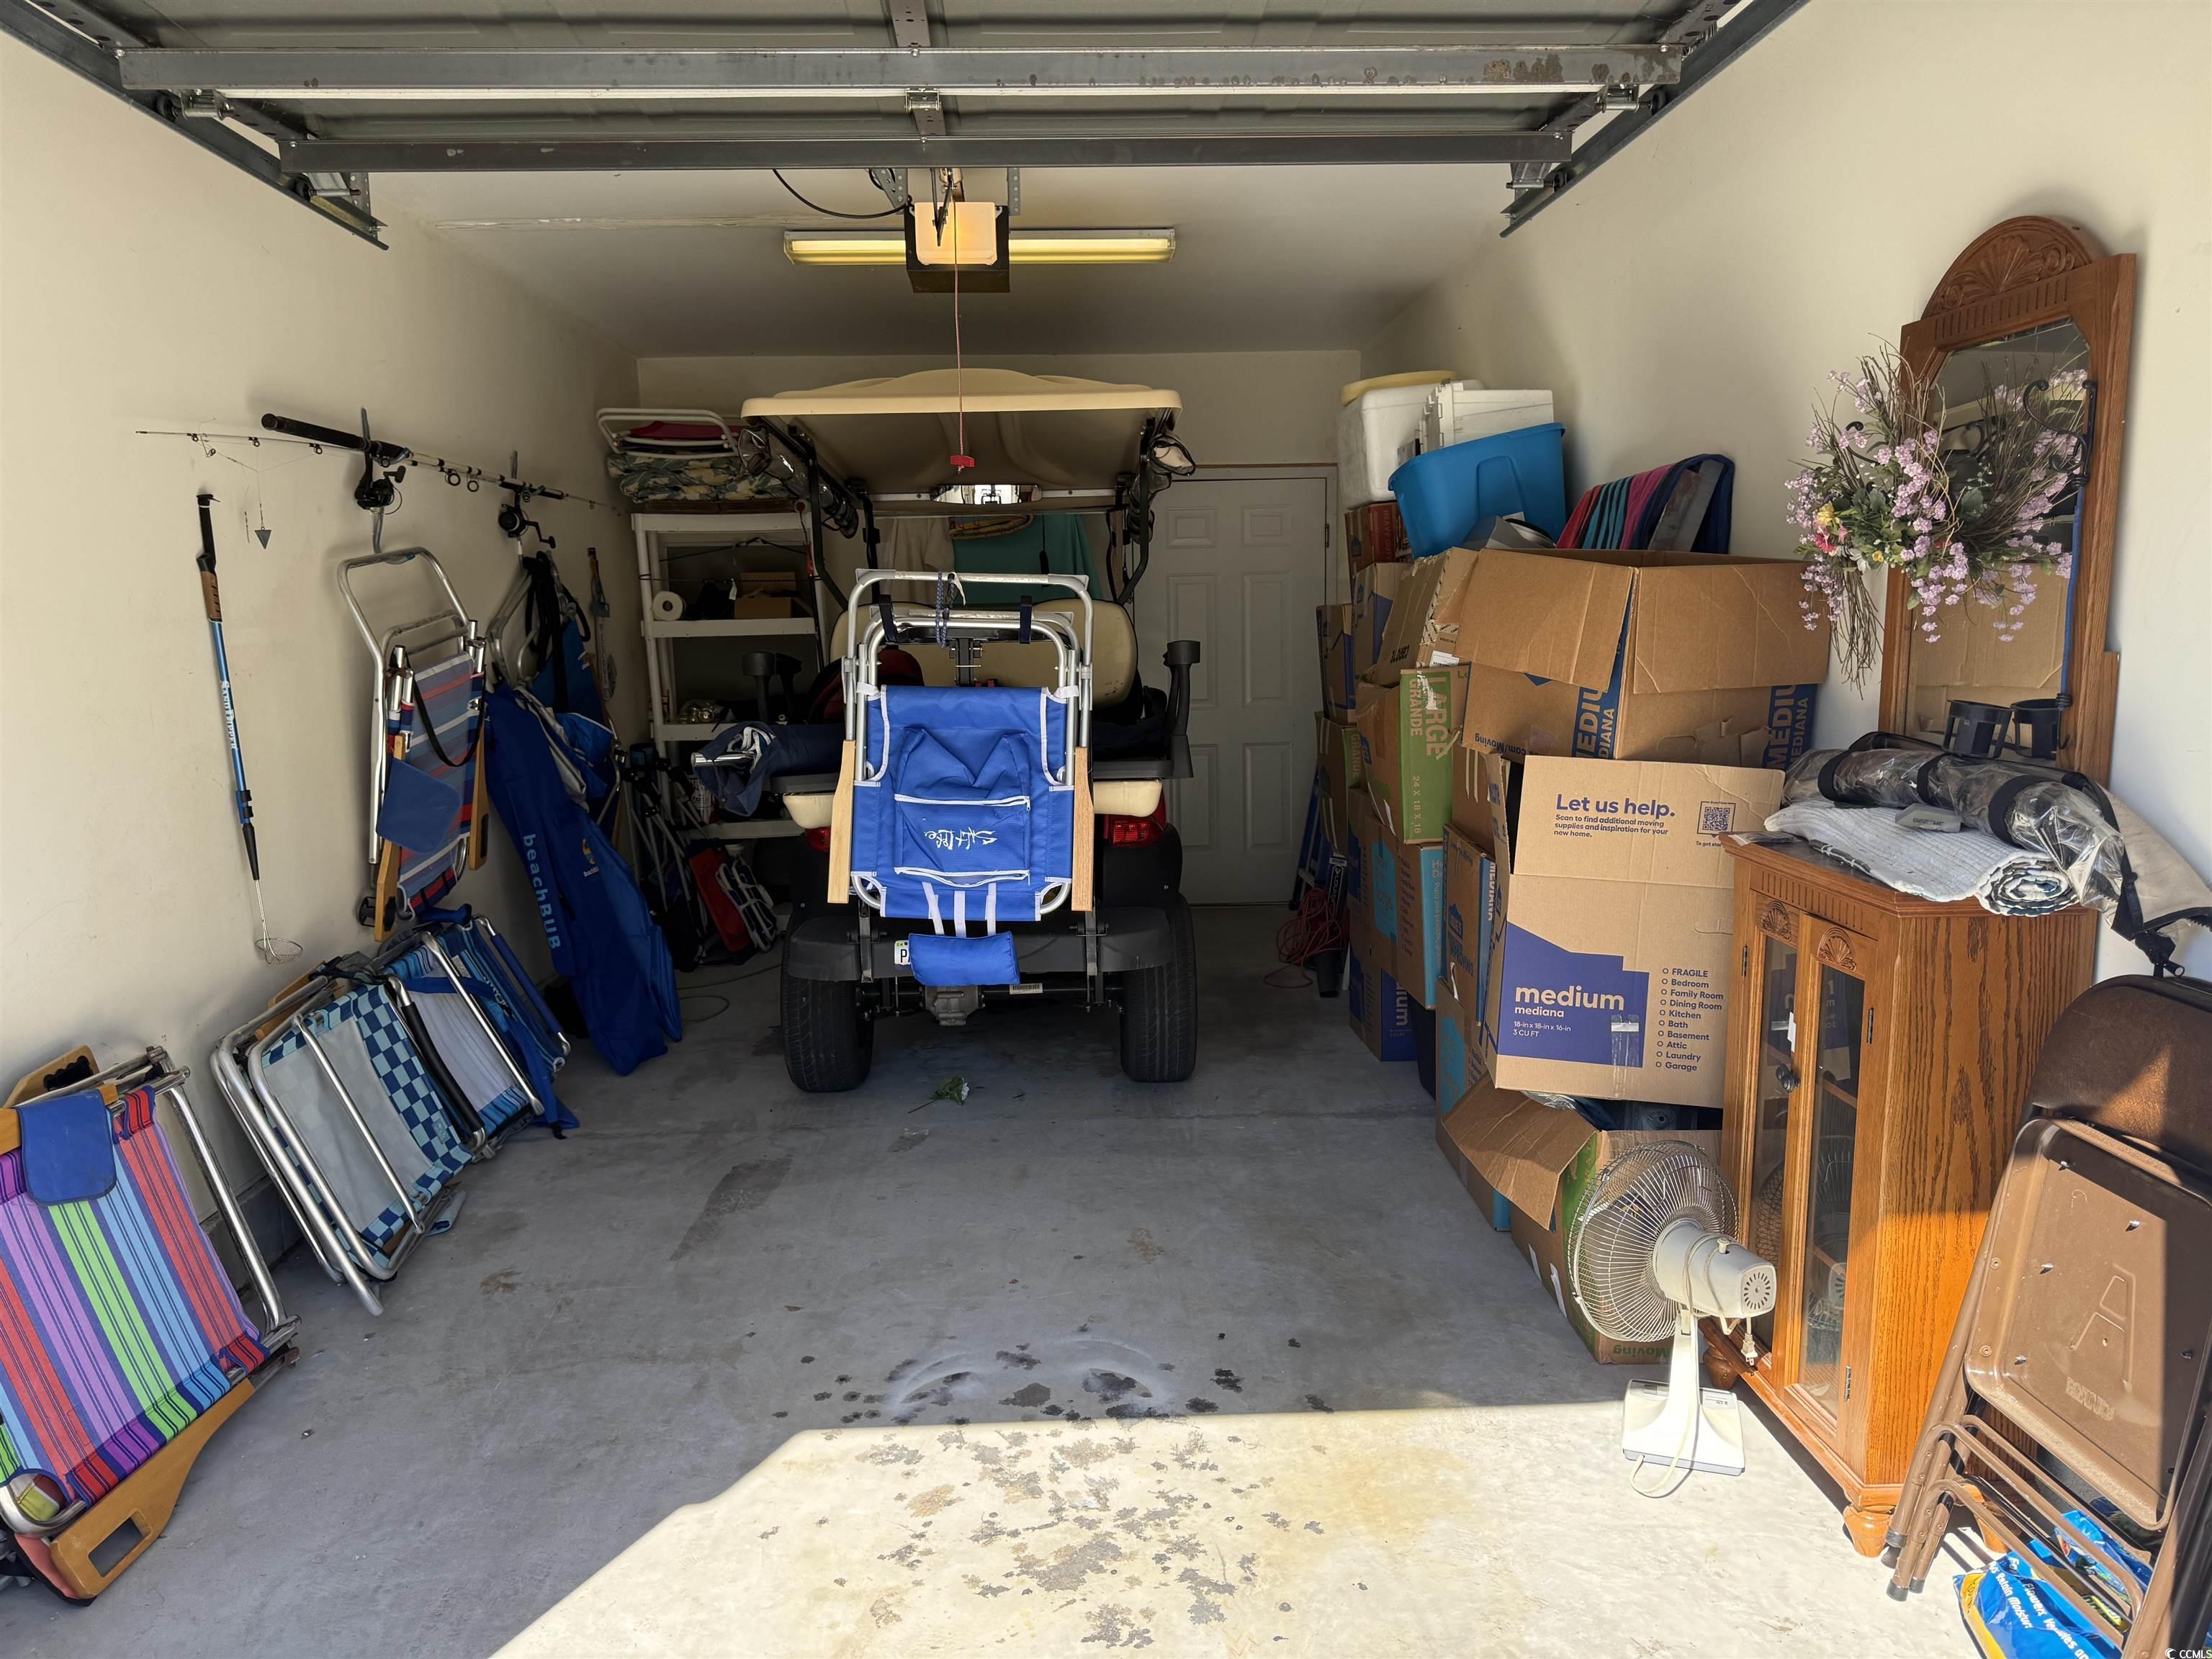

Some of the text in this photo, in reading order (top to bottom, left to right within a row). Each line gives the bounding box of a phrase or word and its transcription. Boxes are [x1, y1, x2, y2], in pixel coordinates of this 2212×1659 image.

[1409, 679, 1423, 736] GRANDE
[1599, 709, 1615, 760] DIANA
[1790, 697, 1809, 763] EDIANA
[1413, 775, 1421, 788] 24
[1413, 801, 1421, 811] 18
[1556, 793, 1676, 819] Let us help.
[1555, 822, 1584, 831] supplies
[1600, 824, 1639, 833] inspiration
[1599, 817, 1637, 825] additional
[1637, 819, 1664, 828] moving
[1414, 824, 1422, 834] 18
[1570, 830, 1592, 838] home.
[521, 833, 561, 950] beachBUB
[1672, 968, 1709, 978] FRAGILE
[1671, 979, 1709, 989] Bedroom
[1515, 985, 1625, 1011] medium
[1671, 989, 1724, 999] Family Room
[1670, 999, 1722, 1010] Dining Room
[1514, 1006, 1565, 1018] mediana
[1669, 1010, 1701, 1019] Kitchen
[1514, 1021, 1529, 1030] 18-in
[1668, 1020, 1689, 1029] Bath
[1668, 1030, 1710, 1040] Basement
[1666, 1051, 1701, 1062] Laundry
[1665, 1062, 1697, 1072] Garage
